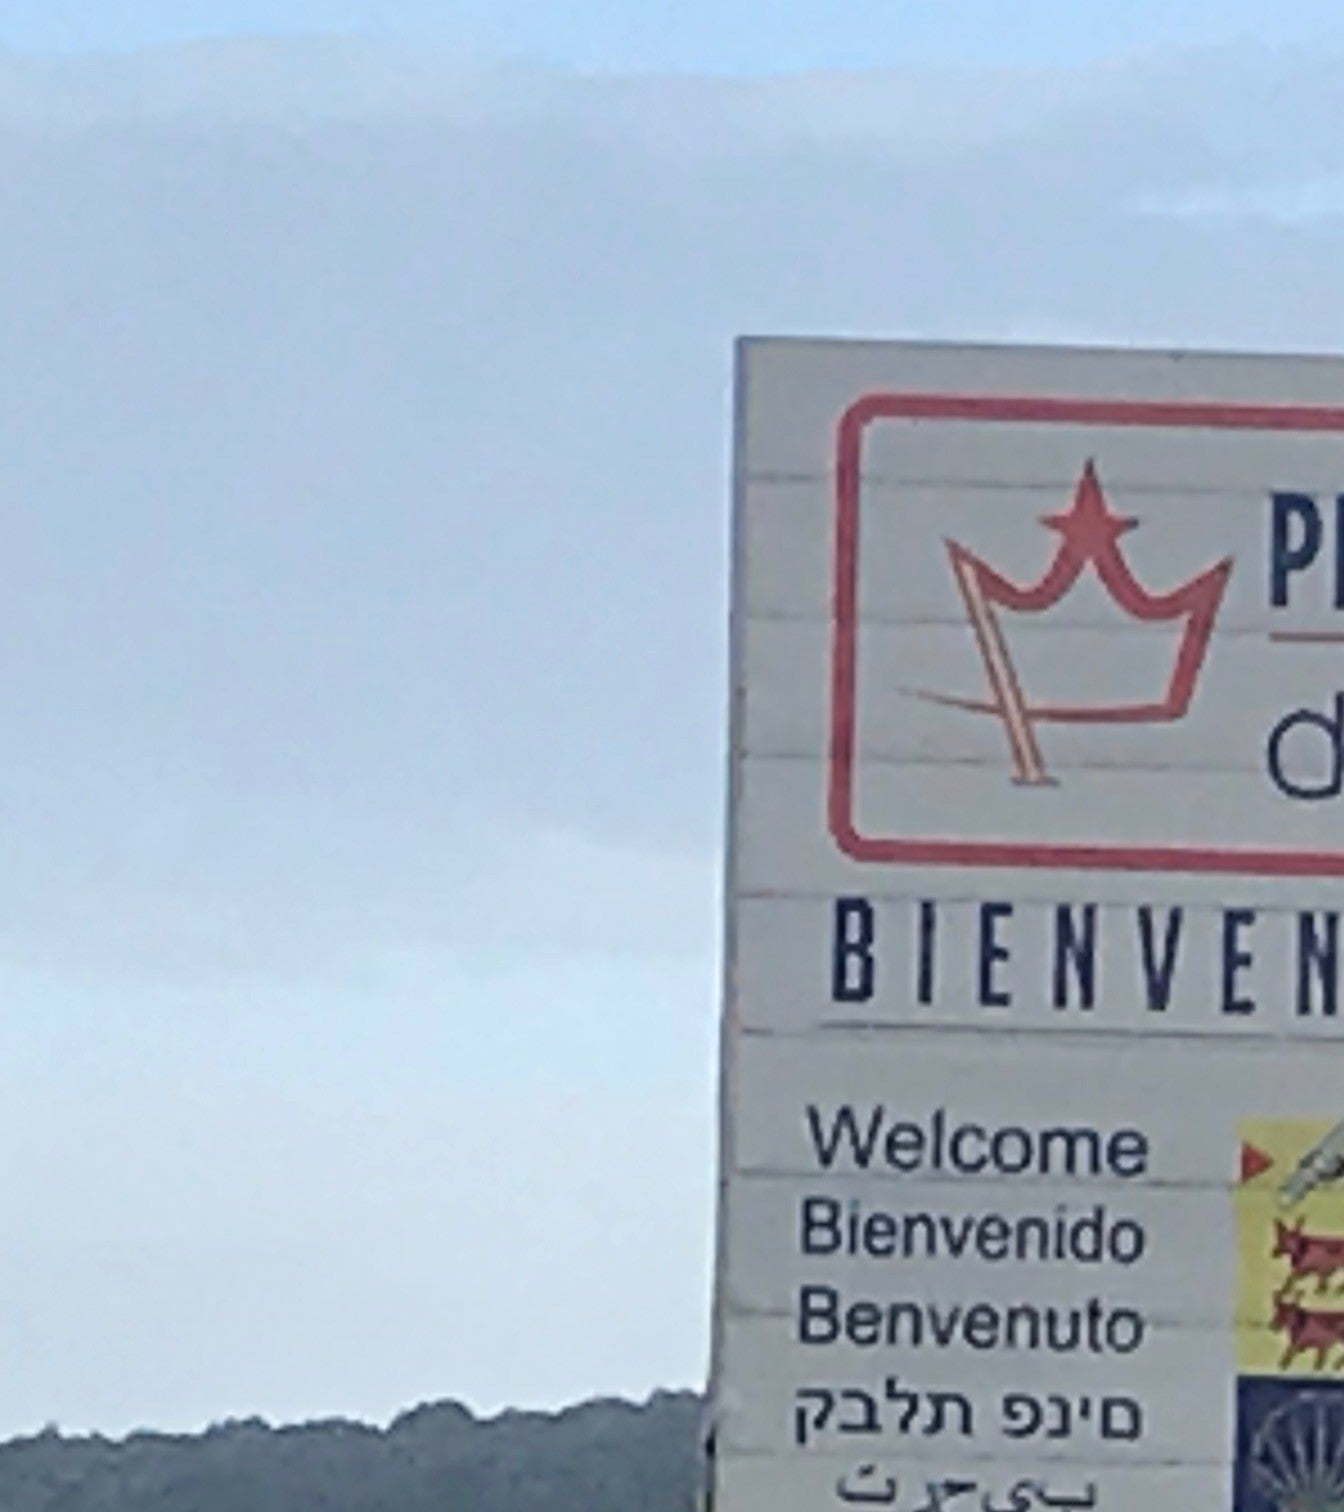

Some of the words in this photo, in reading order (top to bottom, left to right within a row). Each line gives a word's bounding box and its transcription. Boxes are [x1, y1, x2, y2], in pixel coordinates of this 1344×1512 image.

[806, 1103, 1150, 1176] Welcome
[800, 1197, 1146, 1265] Bienvenido
[798, 1285, 1144, 1354] Benvenuto
